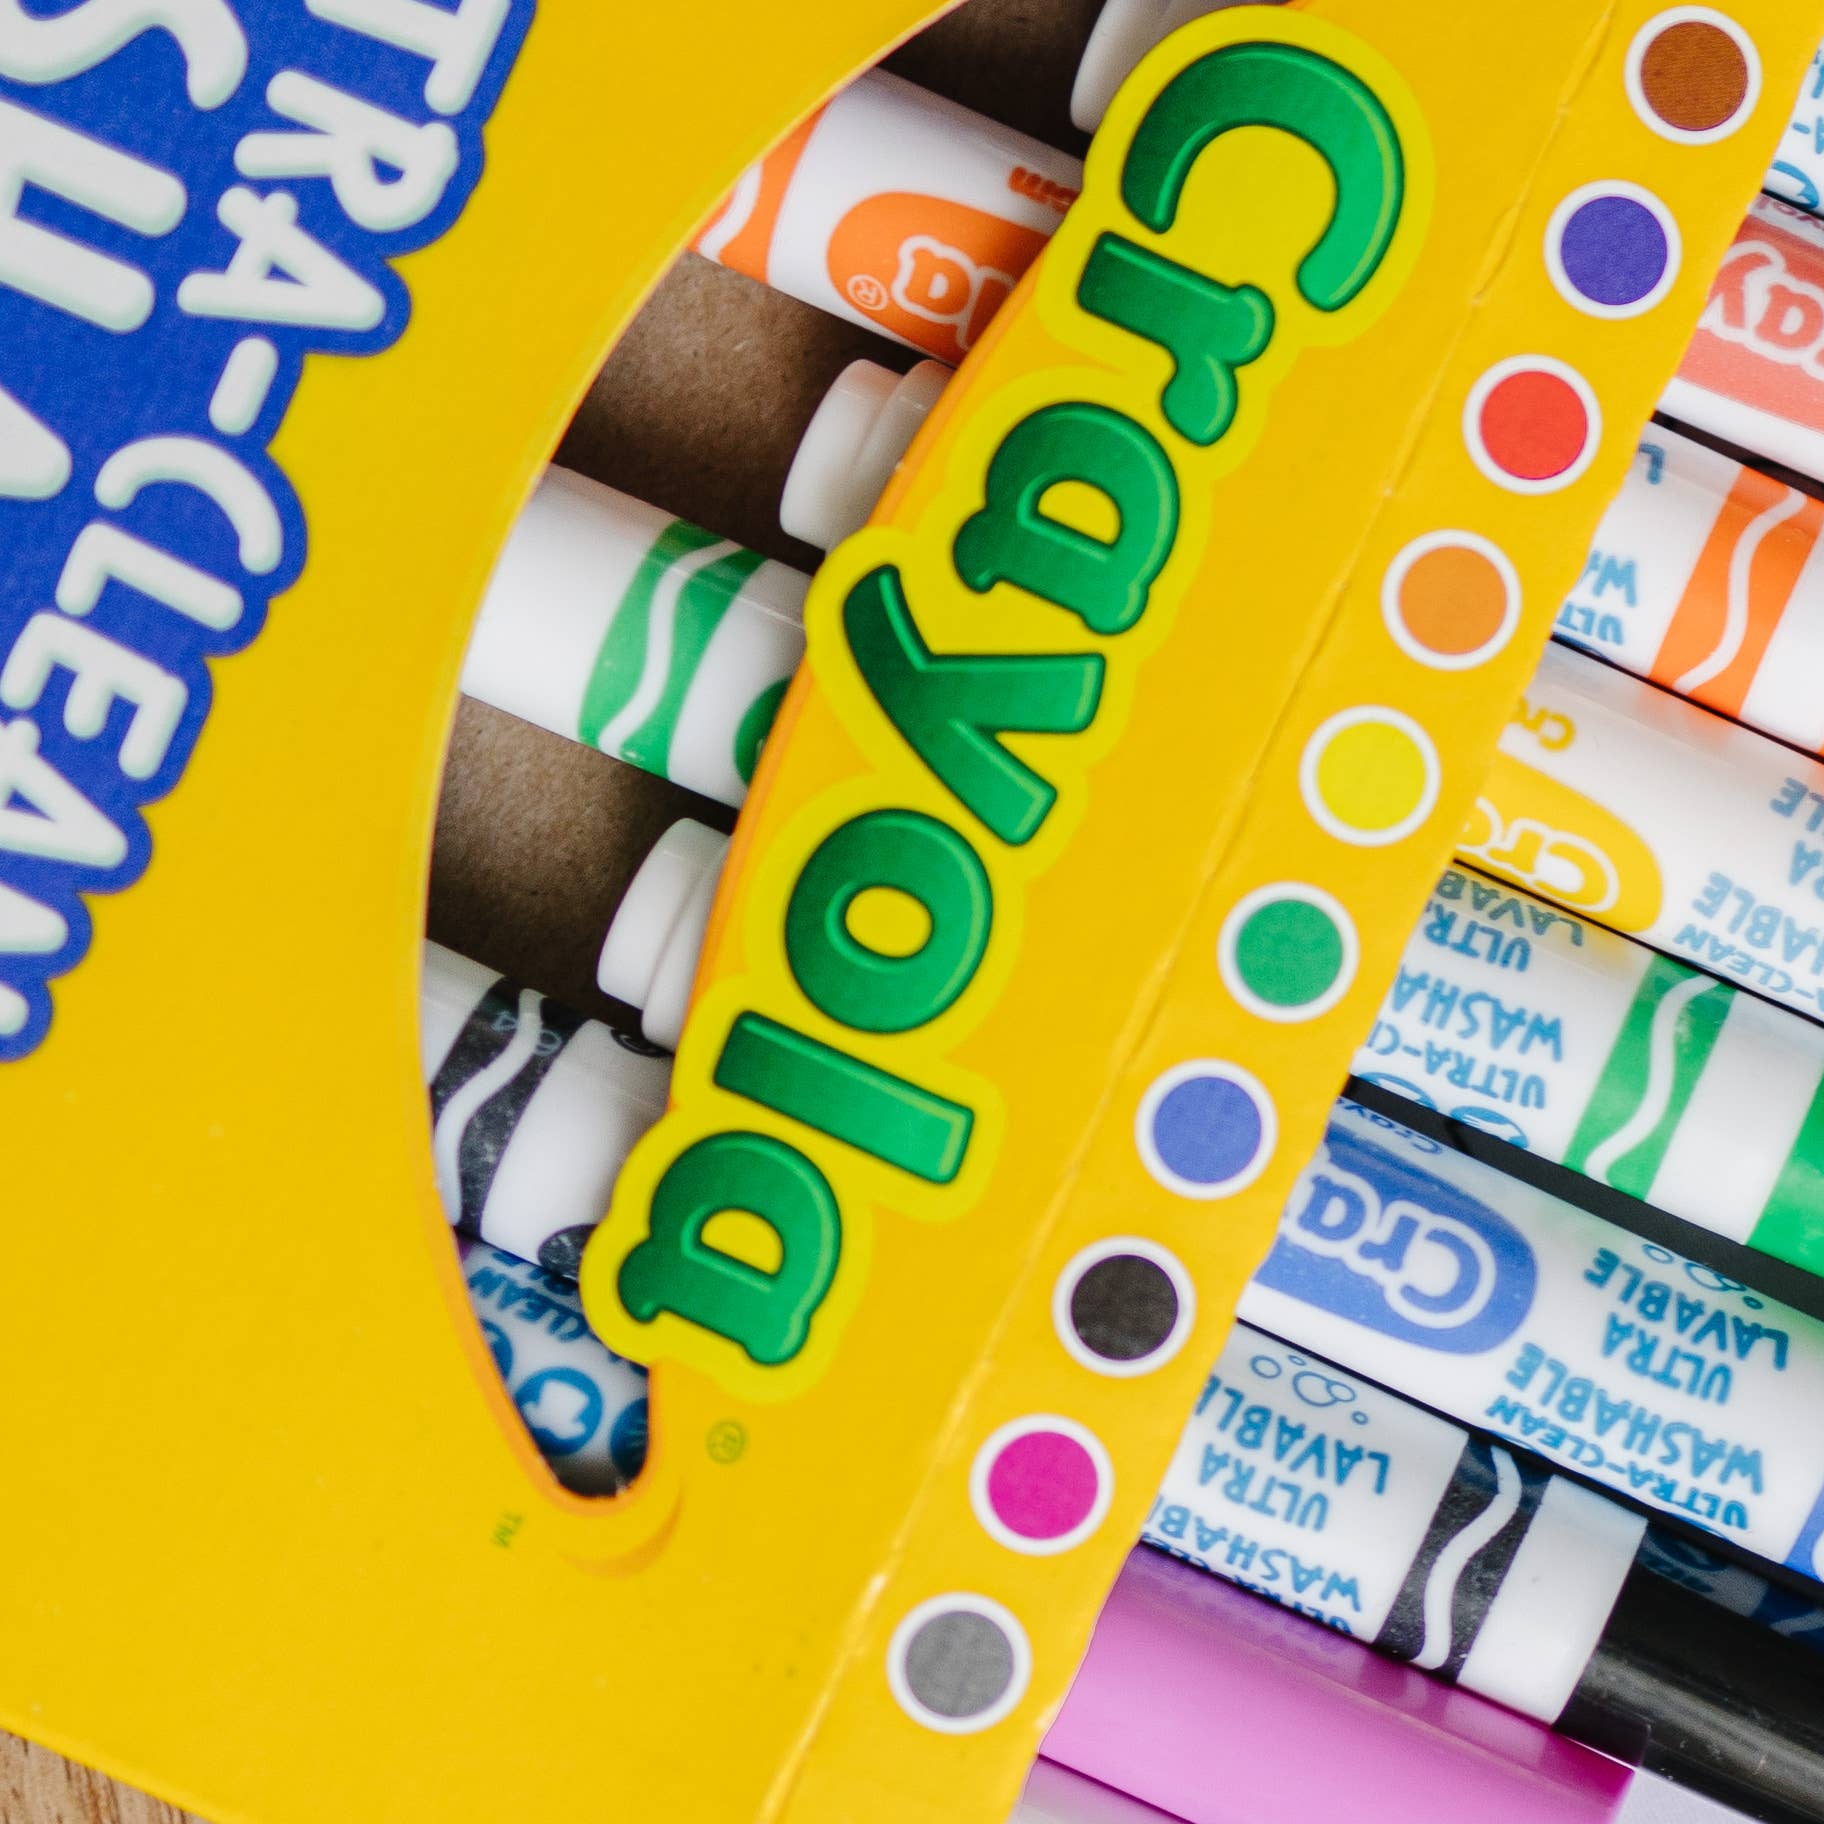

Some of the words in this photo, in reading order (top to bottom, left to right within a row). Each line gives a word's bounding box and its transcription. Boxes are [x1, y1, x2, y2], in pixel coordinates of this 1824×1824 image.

[616, 42, 1404, 1367] Crayola
[1420, 897, 1531, 975] ULTR
[1290, 1164, 1497, 1328] Cra
[1583, 1247, 1791, 1372] LAVABLE
[1505, 1341, 1765, 1497] WASHABLE
[1600, 1313, 1733, 1406] ULTRA
[1198, 1442, 1331, 1533] ULTRA
[1485, 1394, 1751, 1532] ULTRA-CLEAN
